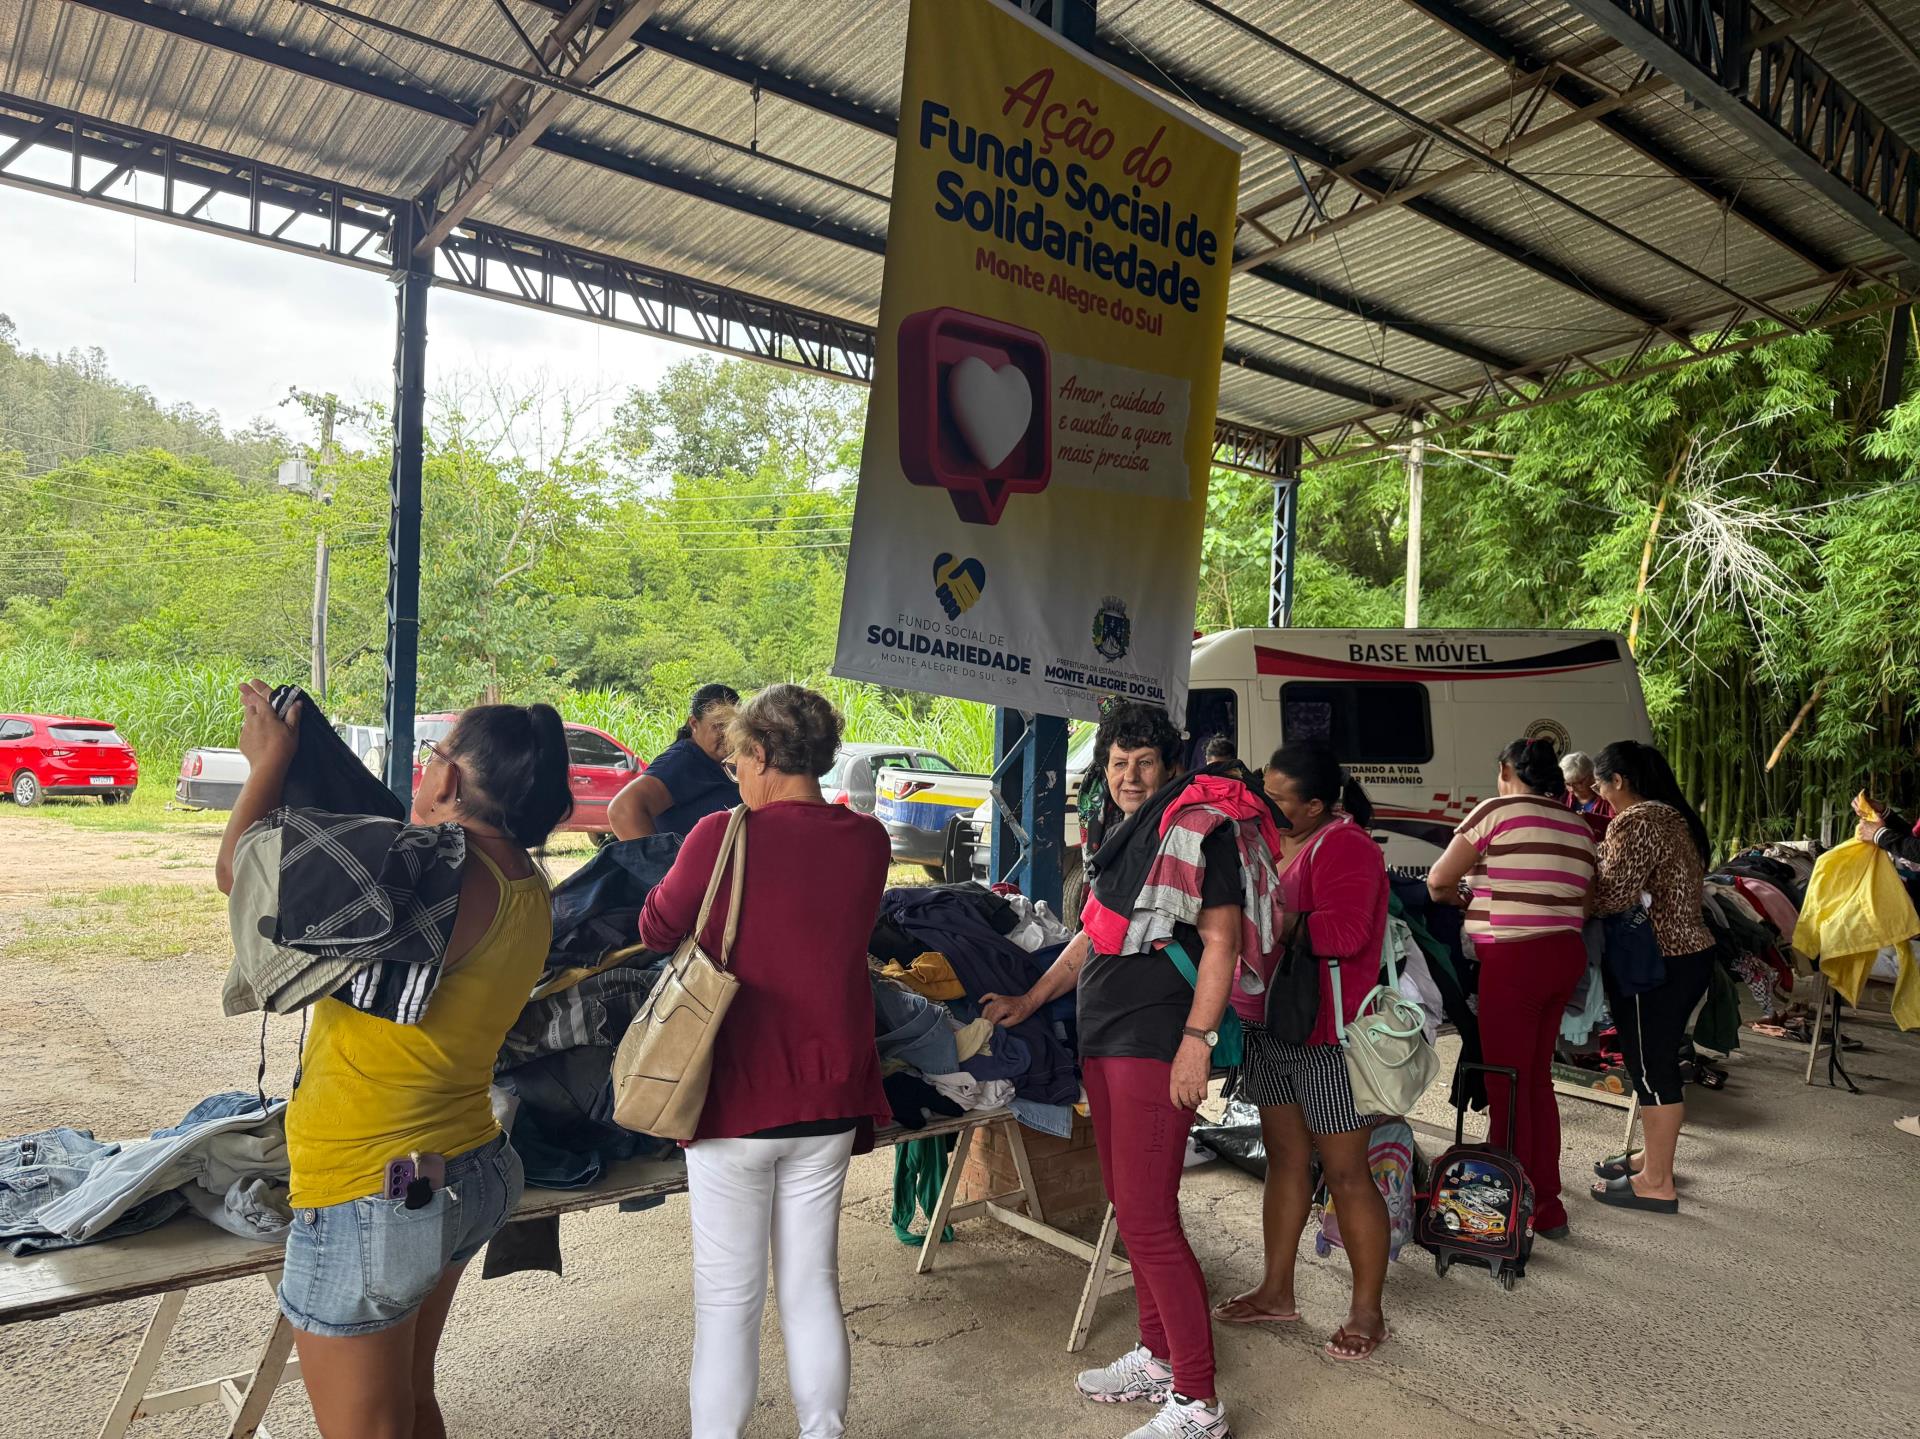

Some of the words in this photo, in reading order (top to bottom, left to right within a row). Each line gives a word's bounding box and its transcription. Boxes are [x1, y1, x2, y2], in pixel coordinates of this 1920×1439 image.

[1002, 68, 1115, 160] Ação
[1122, 126, 1172, 188] do
[920, 99, 1059, 198] Fundo
[1065, 163, 1171, 249] Social
[1175, 213, 1217, 266] de
[935, 170, 1201, 313] Solidariedade
[975, 247, 1044, 292] Monte
[1047, 273, 1107, 314] Alegre
[1110, 299, 1134, 325] do
[1135, 313, 1163, 336] Sul
[1110, 388, 1165, 416] cuidado
[1121, 426, 1132, 440] a
[1134, 427, 1173, 451] quem
[1057, 443, 1094, 464] mais
[1091, 447, 1150, 475] precisa
[898, 614, 941, 633] FUNDO
[944, 624, 985, 643] SOCIAL
[989, 634, 1006, 647] DE
[867, 624, 1031, 675] SOLIDARIEDADE
[1056, 657, 1089, 671] PREFEITURA
[1089, 665, 1098, 673] DA
[1349, 644, 1409, 662] BASE
[1414, 640, 1494, 662] MÓVEL
[881, 652, 917, 667] MONTE
[920, 660, 959, 675] ALEGRE
[962, 667, 976, 677] DO
[979, 671, 997, 683] SUL
[1006, 676, 1018, 686] SP
[1044, 665, 1085, 684] MONTE
[1086, 674, 1127, 692] ALEGRE
[1129, 683, 1145, 695] DO
[1147, 685, 1166, 700] SUL
[1053, 686, 1085, 700] GOVERNO
[1389, 766, 1395, 774] A
[1397, 766, 1420, 774] VIDA
